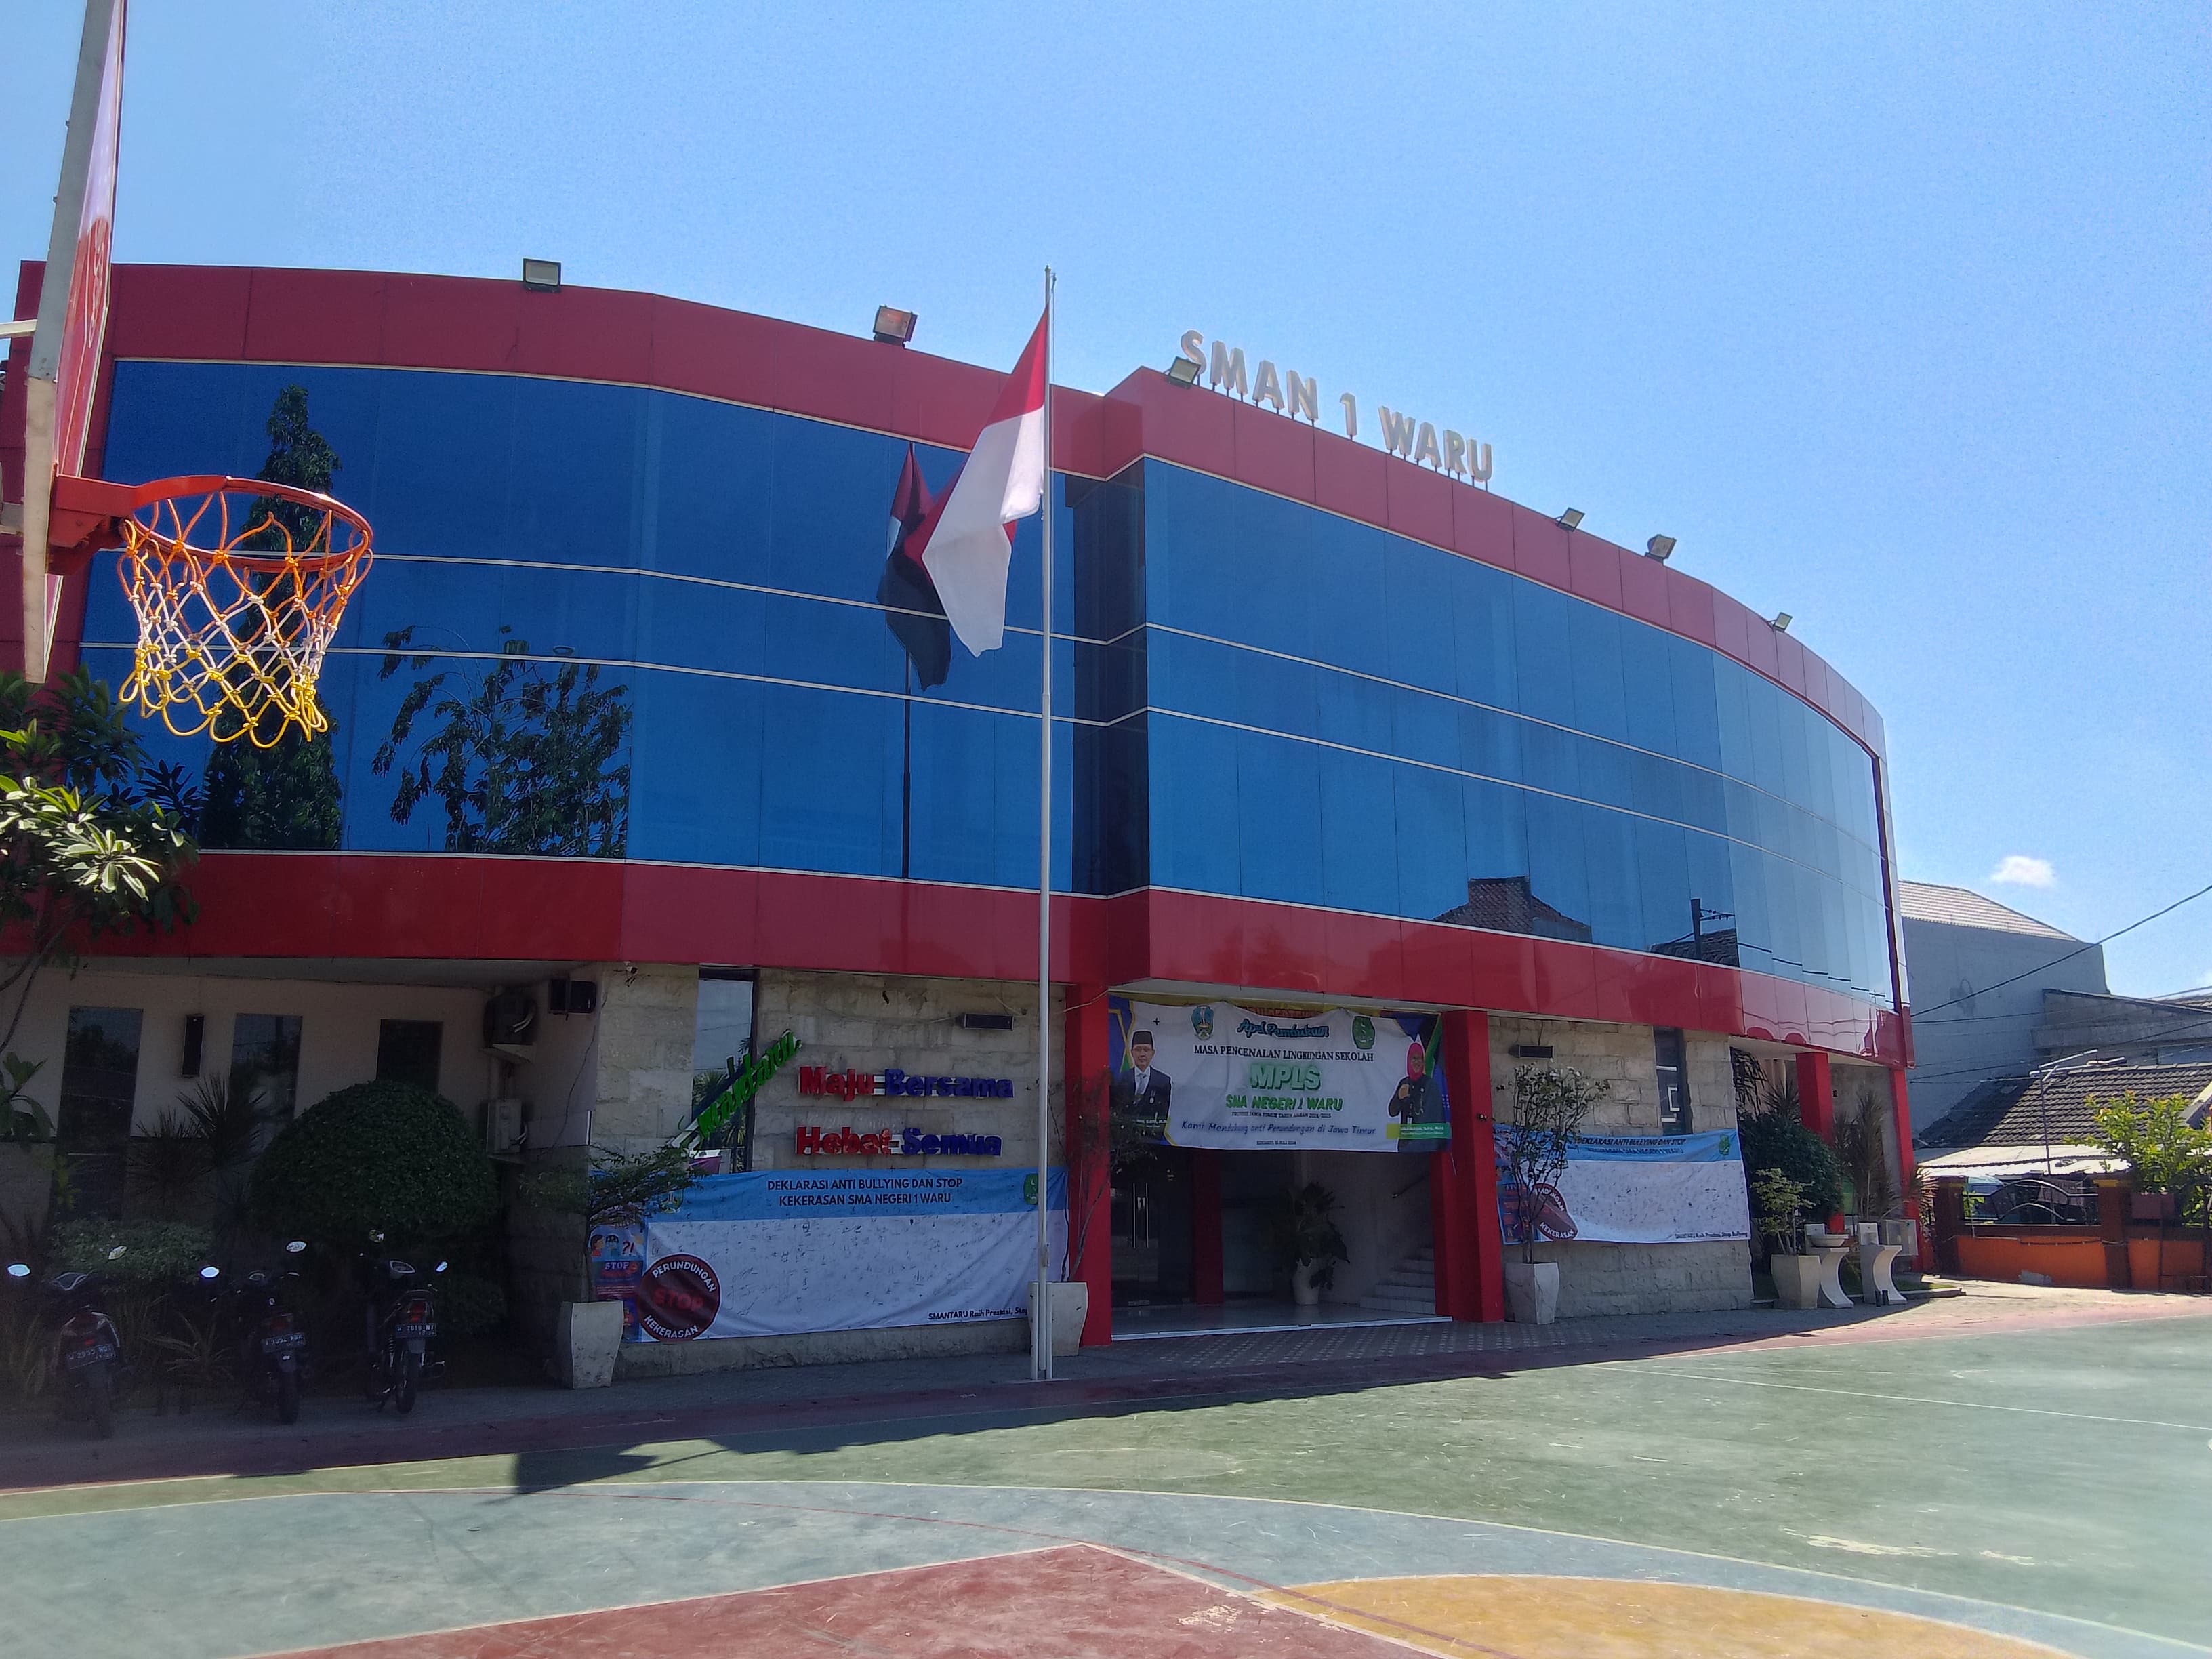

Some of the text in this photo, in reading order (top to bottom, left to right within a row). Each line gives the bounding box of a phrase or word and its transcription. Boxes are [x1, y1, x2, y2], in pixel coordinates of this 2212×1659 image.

[1181, 329, 1493, 482] SMAN 1 WARU
[1194, 1044, 1218, 1054] MASA
[1283, 1050, 1334, 1060] LINGKUNGAN
[1335, 1052, 1374, 1061] SEKOLAH
[799, 1065, 1014, 1101] Maju Bersama
[1250, 1063, 1322, 1090] MPLS
[1226, 1094, 1247, 1108] SMA
[1252, 1095, 1297, 1110] NEGERI
[1307, 1097, 1344, 1111] WARU
[1181, 1120, 1204, 1130] Kami
[1317, 1124, 1326, 1133] di
[1328, 1125, 1349, 1134] Jawa
[1352, 1126, 1376, 1134] Timur
[796, 1126, 1002, 1156] Hebat Semua
[767, 1177, 963, 1191] DEKLARASI ANTI BULLYING DAN STOP
[779, 1192, 951, 1206] KEKERASAN SMA NEGERI 1 WARU
[605, 1261, 630, 1270] STOP
[652, 1261, 716, 1292] PERUNDUNGAN
[654, 1289, 704, 1311] STOP
[928, 1310, 968, 1321] SMANTARU
[644, 1315, 699, 1338] KEKERASAN
